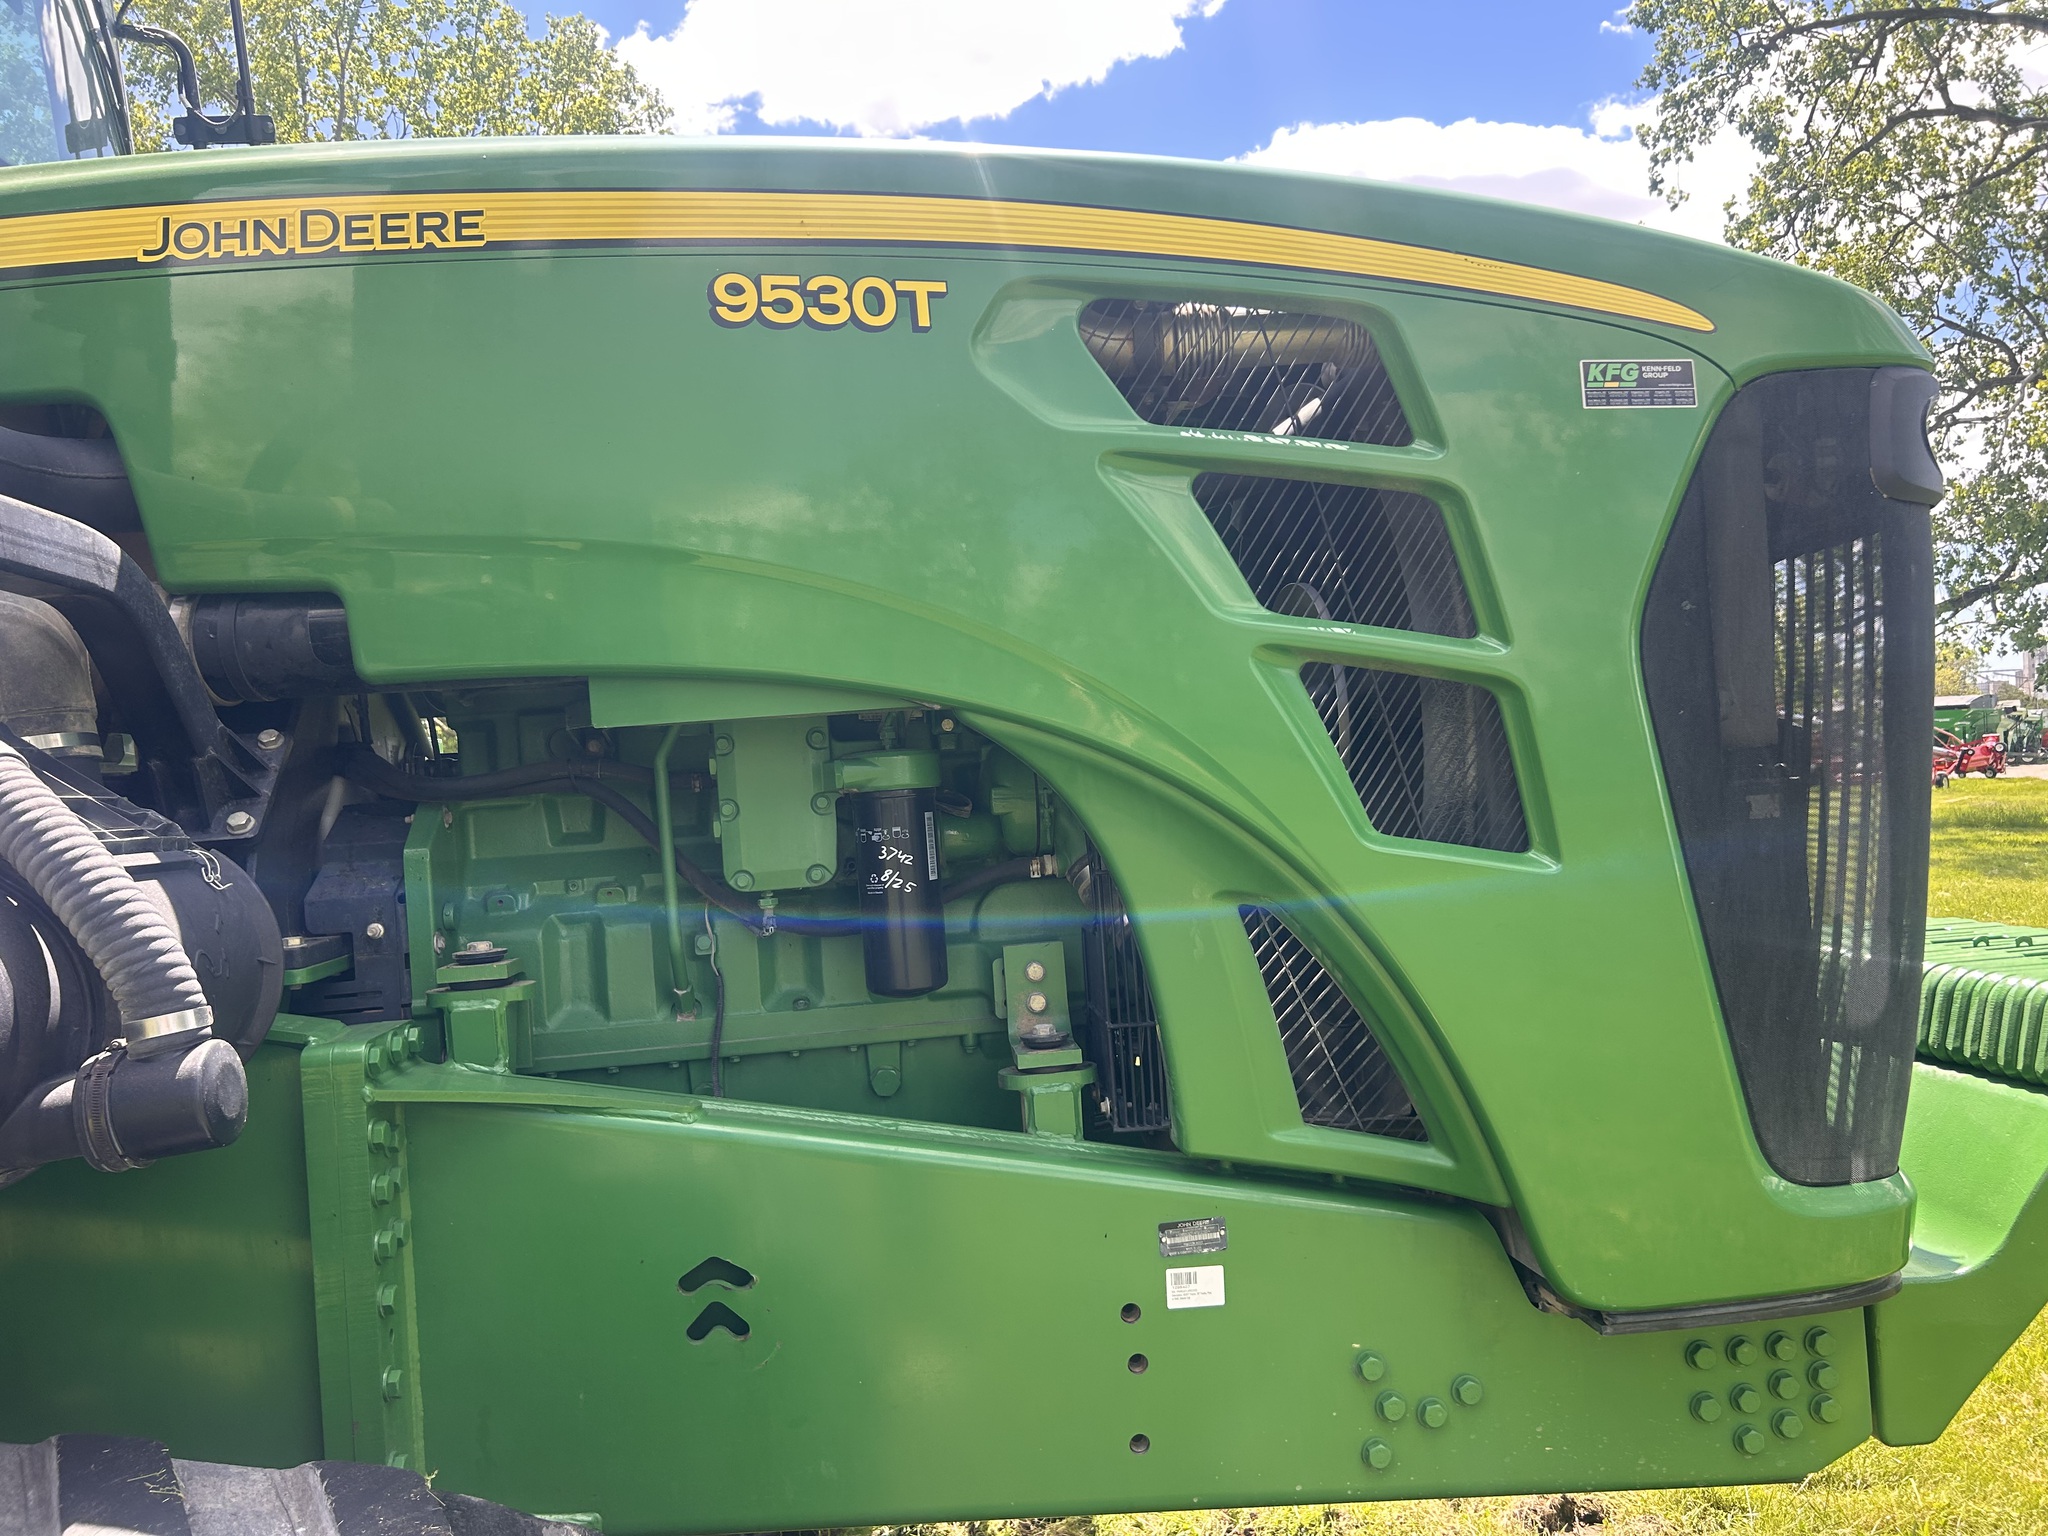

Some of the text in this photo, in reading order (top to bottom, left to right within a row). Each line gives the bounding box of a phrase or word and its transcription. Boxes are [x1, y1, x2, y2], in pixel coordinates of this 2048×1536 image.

[138, 208, 487, 262] JOHN DEERE
[707, 271, 949, 333] 9530T
[1588, 363, 1639, 381] KFG
[878, 846, 913, 865] 3742
[880, 869, 917, 892] 8/25
